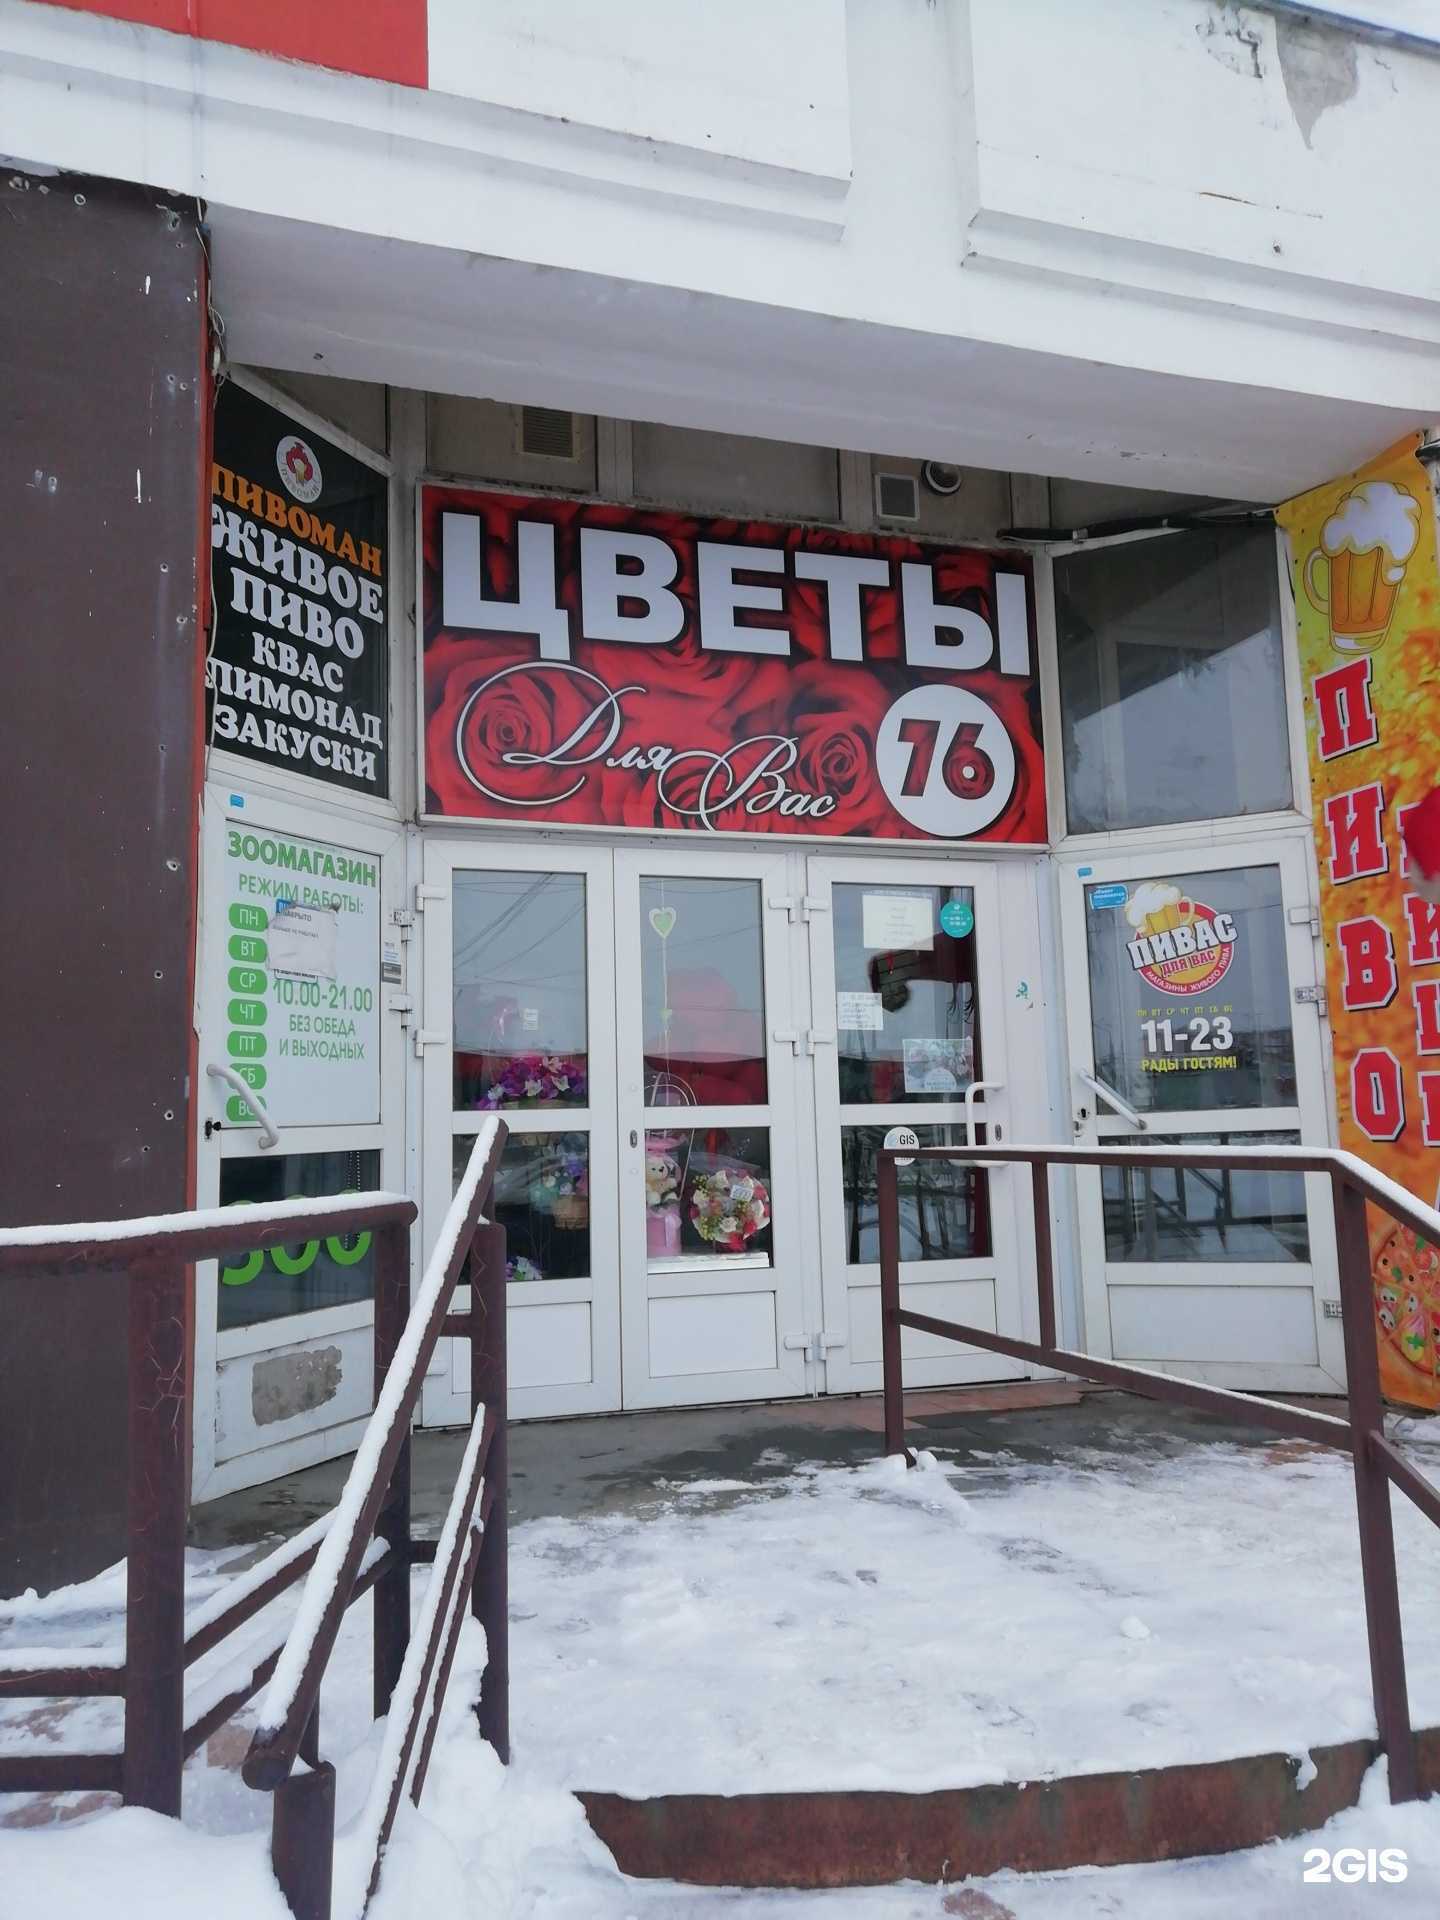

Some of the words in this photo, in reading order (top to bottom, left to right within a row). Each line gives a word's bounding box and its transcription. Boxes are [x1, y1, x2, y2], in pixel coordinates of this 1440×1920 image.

[211, 461, 383, 577] ПИВОМАН
[211, 503, 384, 625] ЖИВОЕ
[442, 511, 1031, 677] ЦВЕТЫ
[229, 566, 365, 660] ПИВО
[251, 631, 345, 694] КВАС
[205, 655, 383, 750] ЛИМОНАД
[214, 703, 377, 782] ЗАКУСКИ
[457, 661, 672, 806] Для
[657, 735, 837, 832] Вас
[898, 717, 996, 802] 76
[227, 830, 377, 888] ЗООМАГАЗИН
[239, 872, 299, 903] РЕЖИМ
[1312, 655, 1405, 1143] ПИВО
[239, 909, 259, 926] ПН
[241, 940, 257, 957] ВТ
[1127, 913, 1238, 970] ПИВАС
[240, 971, 257, 988] СР
[1145, 970, 1188, 992] МАГАЗИНЫ
[1160, 957, 1188, 978] ДЛЯ
[1190, 950, 1216, 967] ВАС
[239, 1003, 257, 1020] ЧТ
[272, 979, 373, 1013] 10.00-21.00
[239, 1035, 257, 1052] ПТ
[289, 1014, 311, 1032] БЕЗ
[313, 1016, 356, 1038] ОБЕДА
[1140, 1016, 1234, 1053] 11-23
[279, 1038, 289, 1056] И
[292, 1039, 366, 1061] ВЫХОДНЫХ
[1141, 1058, 1179, 1073] РАДЫ
[1182, 1055, 1237, 1071] ГОСТЯМ!
